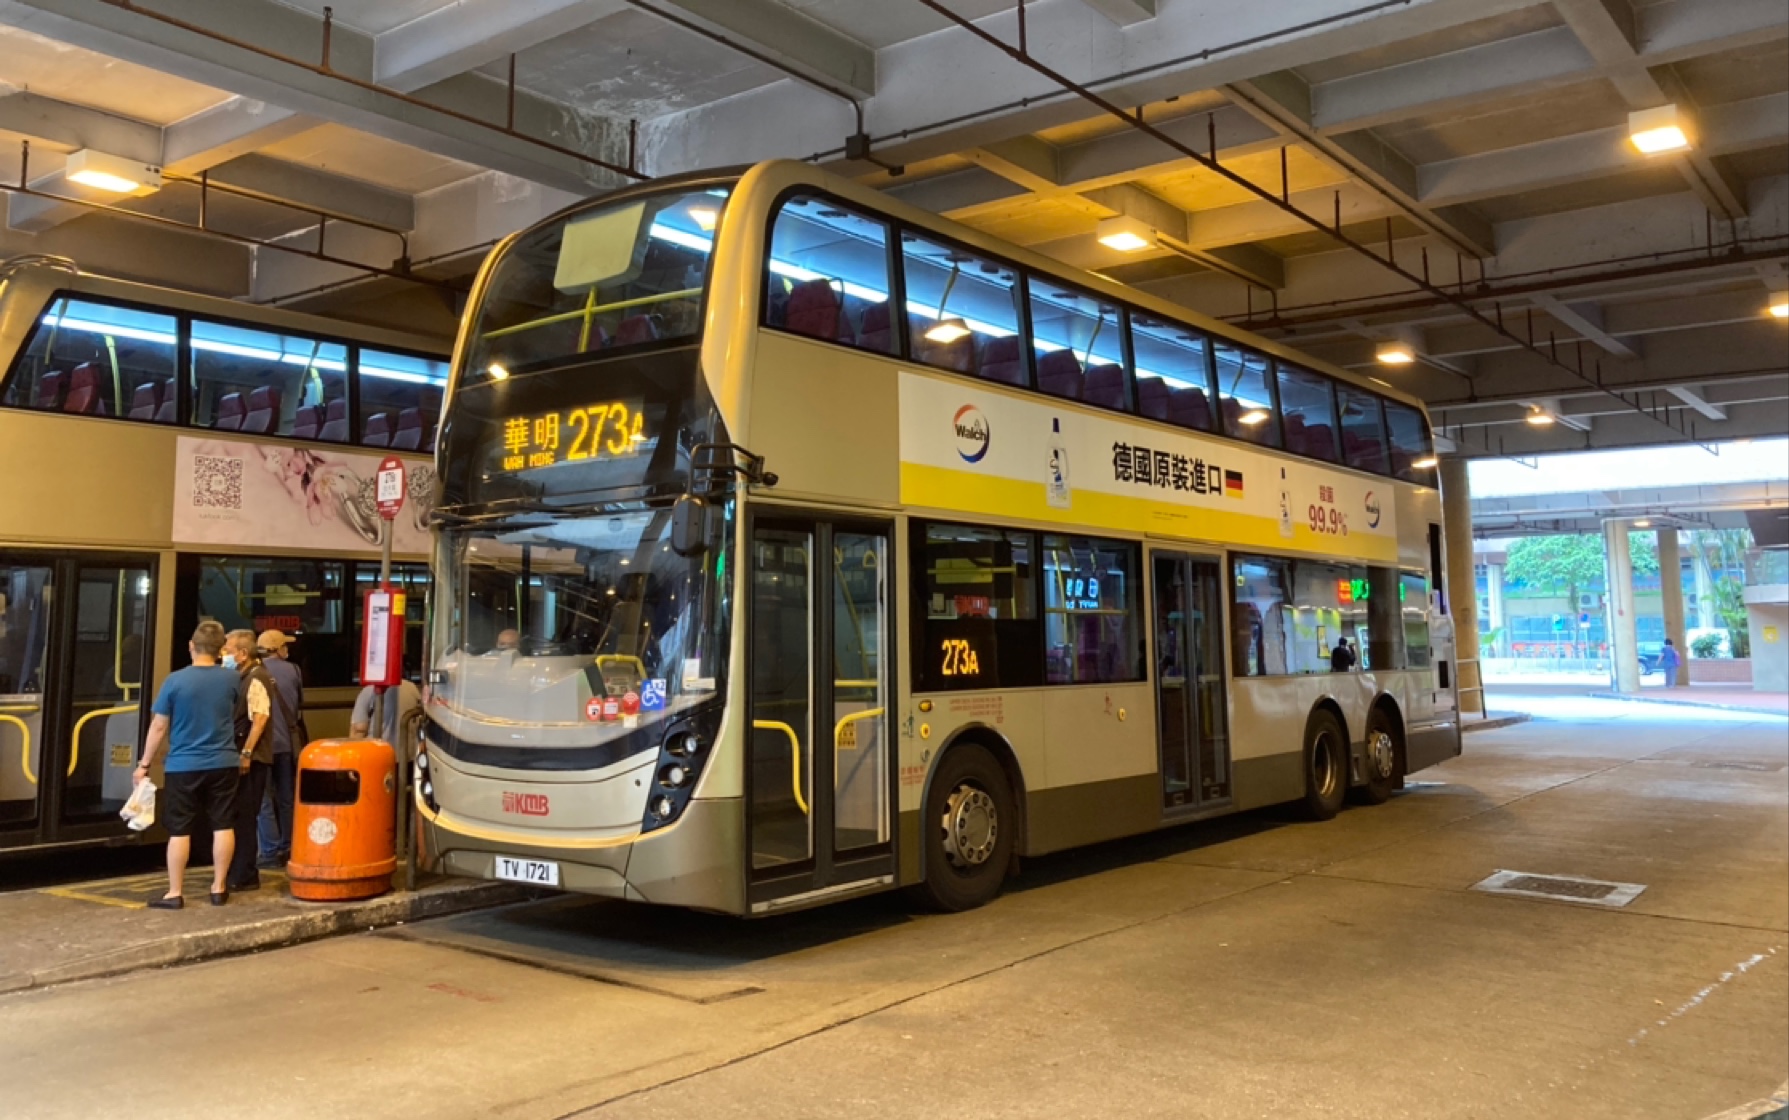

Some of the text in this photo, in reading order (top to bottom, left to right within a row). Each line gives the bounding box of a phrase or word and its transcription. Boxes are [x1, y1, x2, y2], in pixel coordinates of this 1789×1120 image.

[504, 403, 643, 460] 華明 273A
[955, 423, 987, 441] Walch
[1111, 440, 1222, 496] 德國原裝進口
[941, 639, 980, 676] 273A
[503, 860, 550, 881] TV 1721
